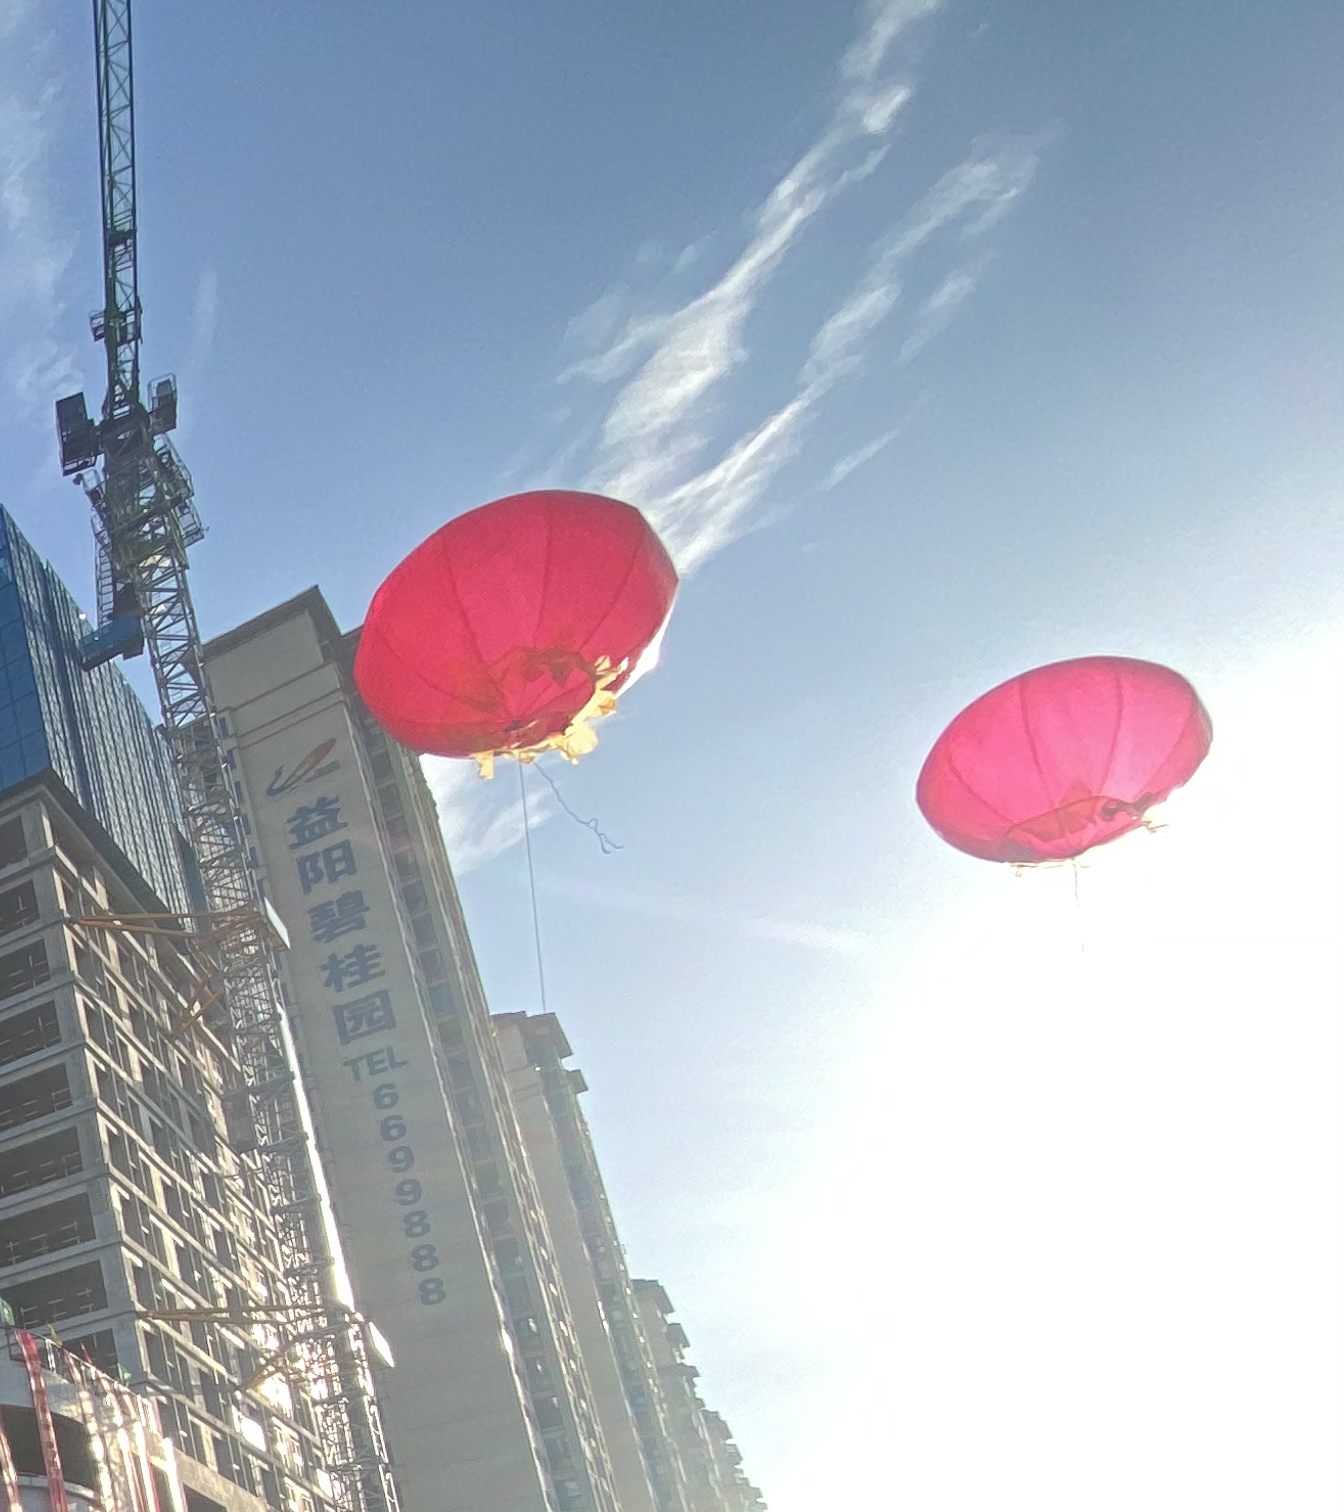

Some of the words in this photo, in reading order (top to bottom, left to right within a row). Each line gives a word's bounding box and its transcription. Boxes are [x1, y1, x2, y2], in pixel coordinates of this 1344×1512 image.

[286, 793, 397, 1048] 益阳碧桂园
[342, 1043, 408, 1085] TEL
[372, 1081, 449, 1306] 6699888
